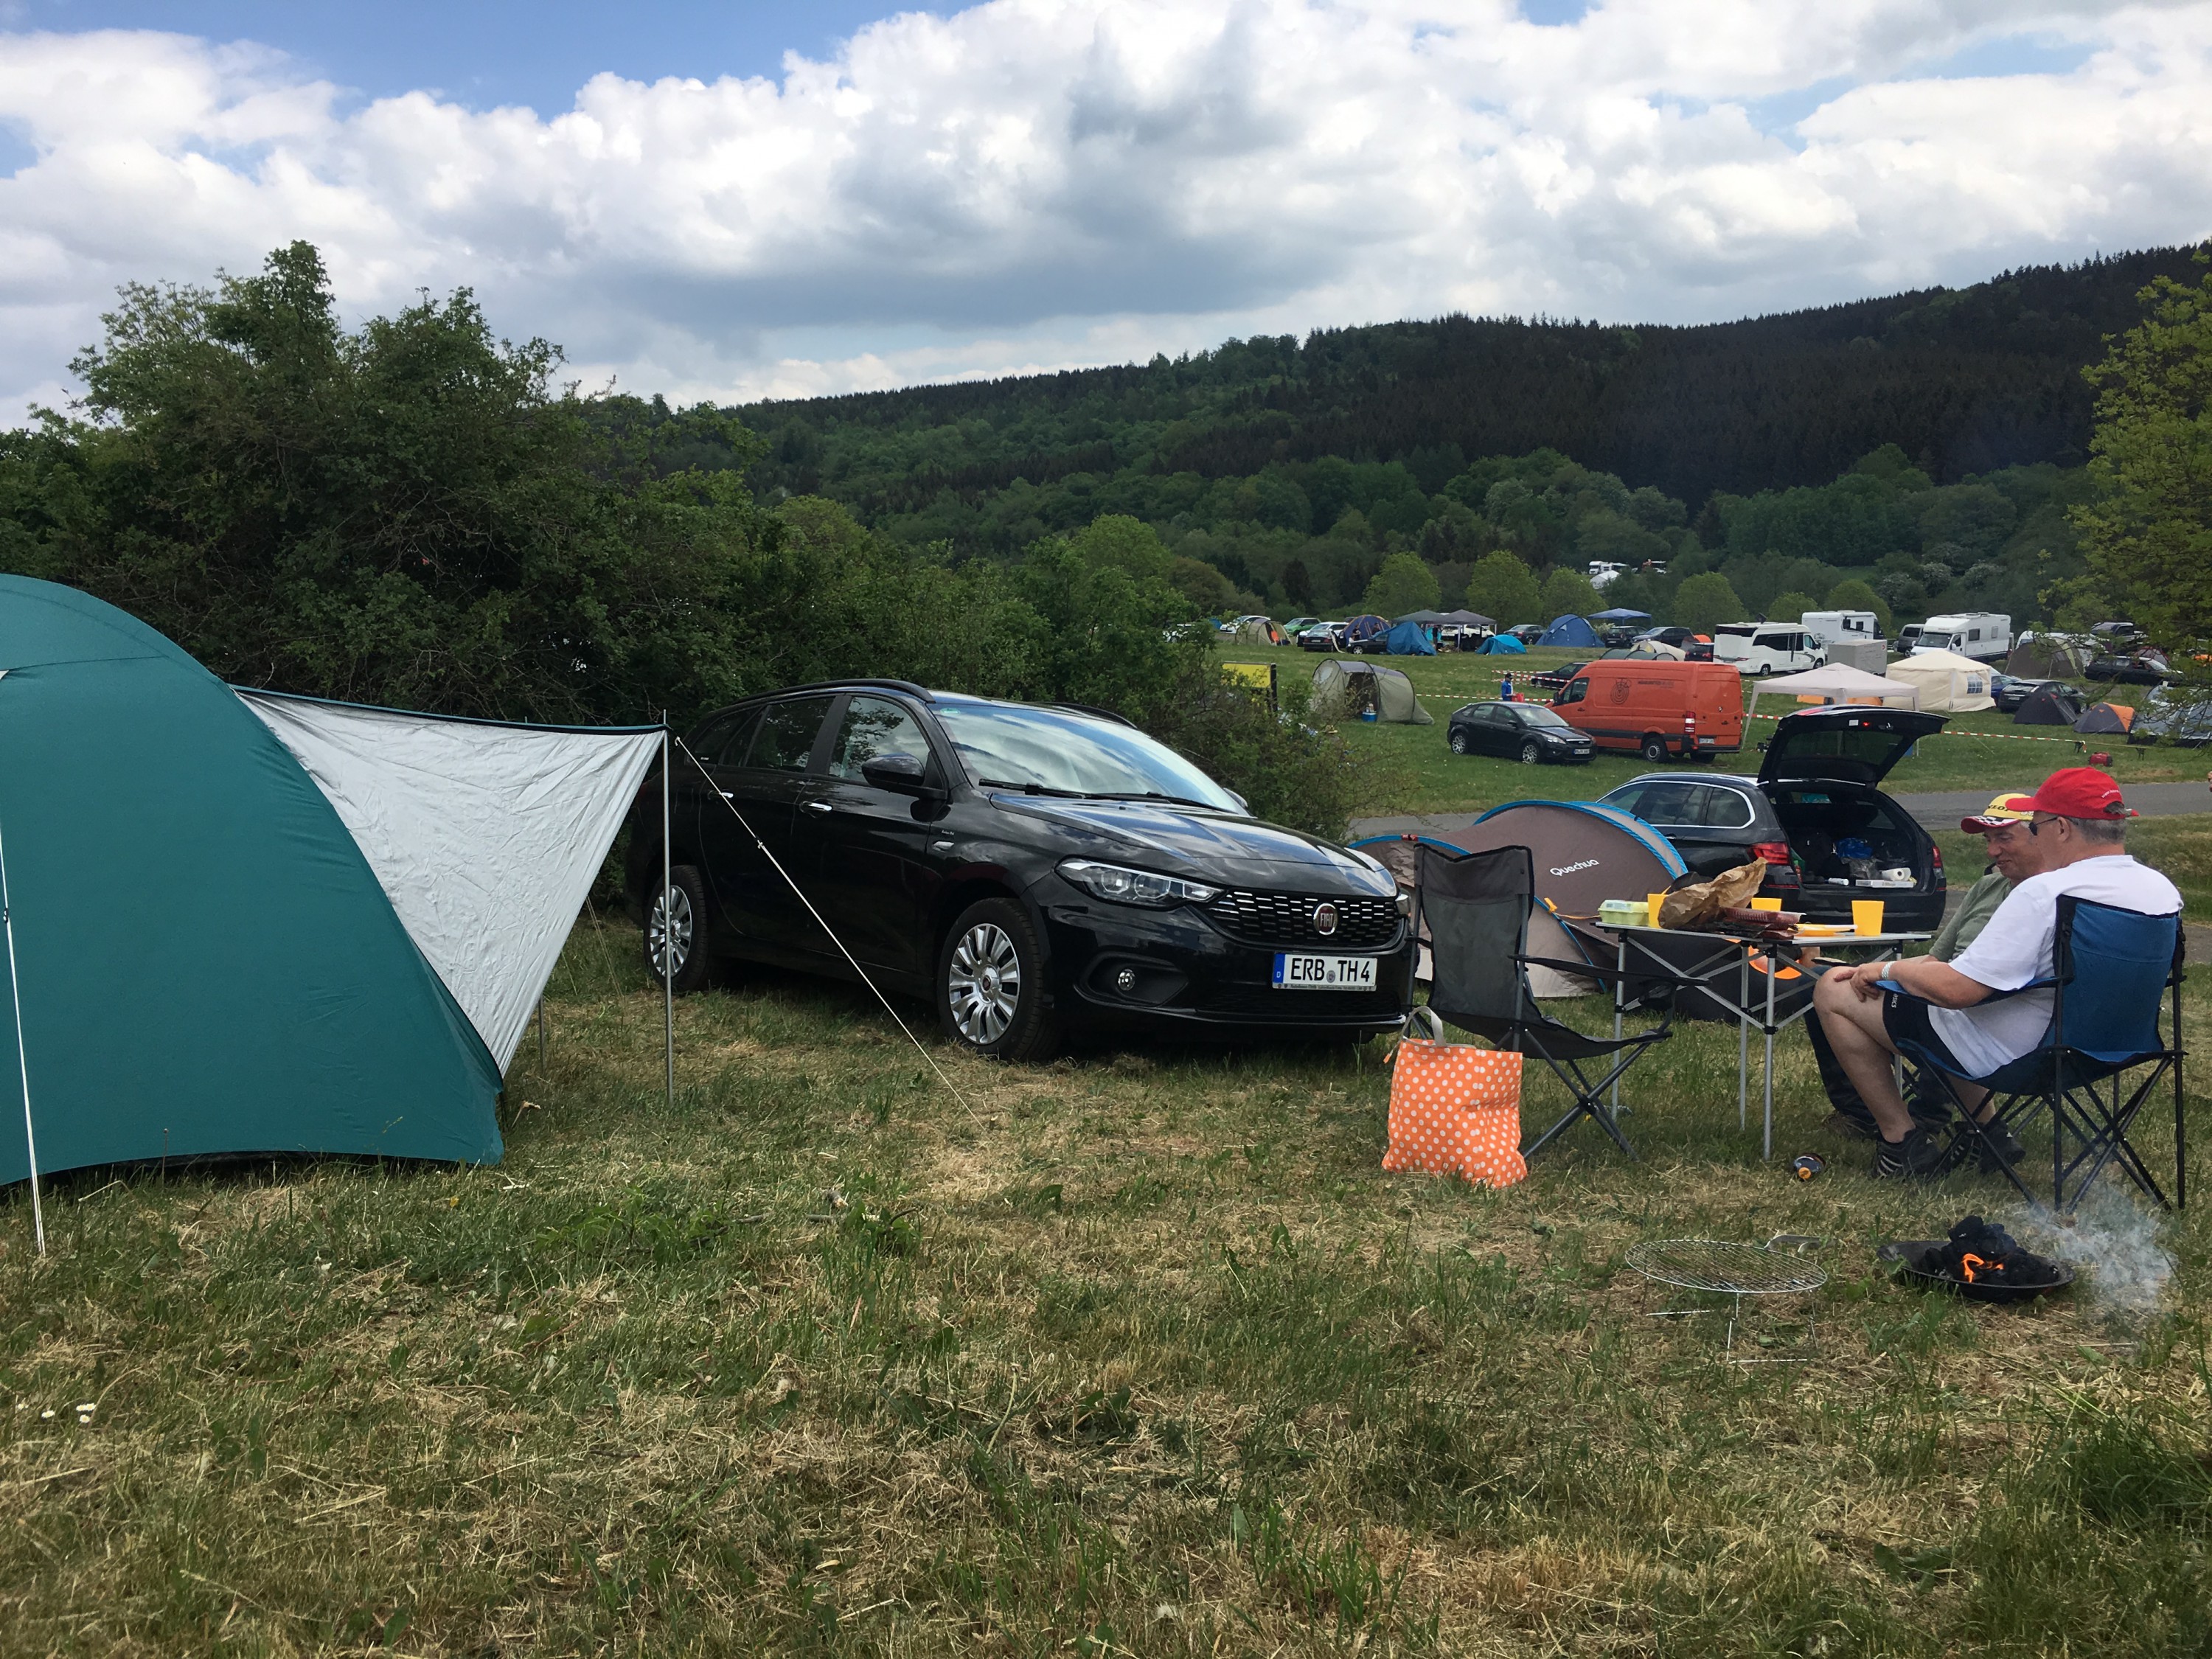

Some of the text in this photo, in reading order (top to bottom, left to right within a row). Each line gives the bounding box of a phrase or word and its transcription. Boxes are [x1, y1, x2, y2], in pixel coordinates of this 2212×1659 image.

[1549, 858, 1600, 877] Quechua
[1320, 912, 1334, 928] FIAT
[1290, 958, 1370, 982] ERB TH 4
